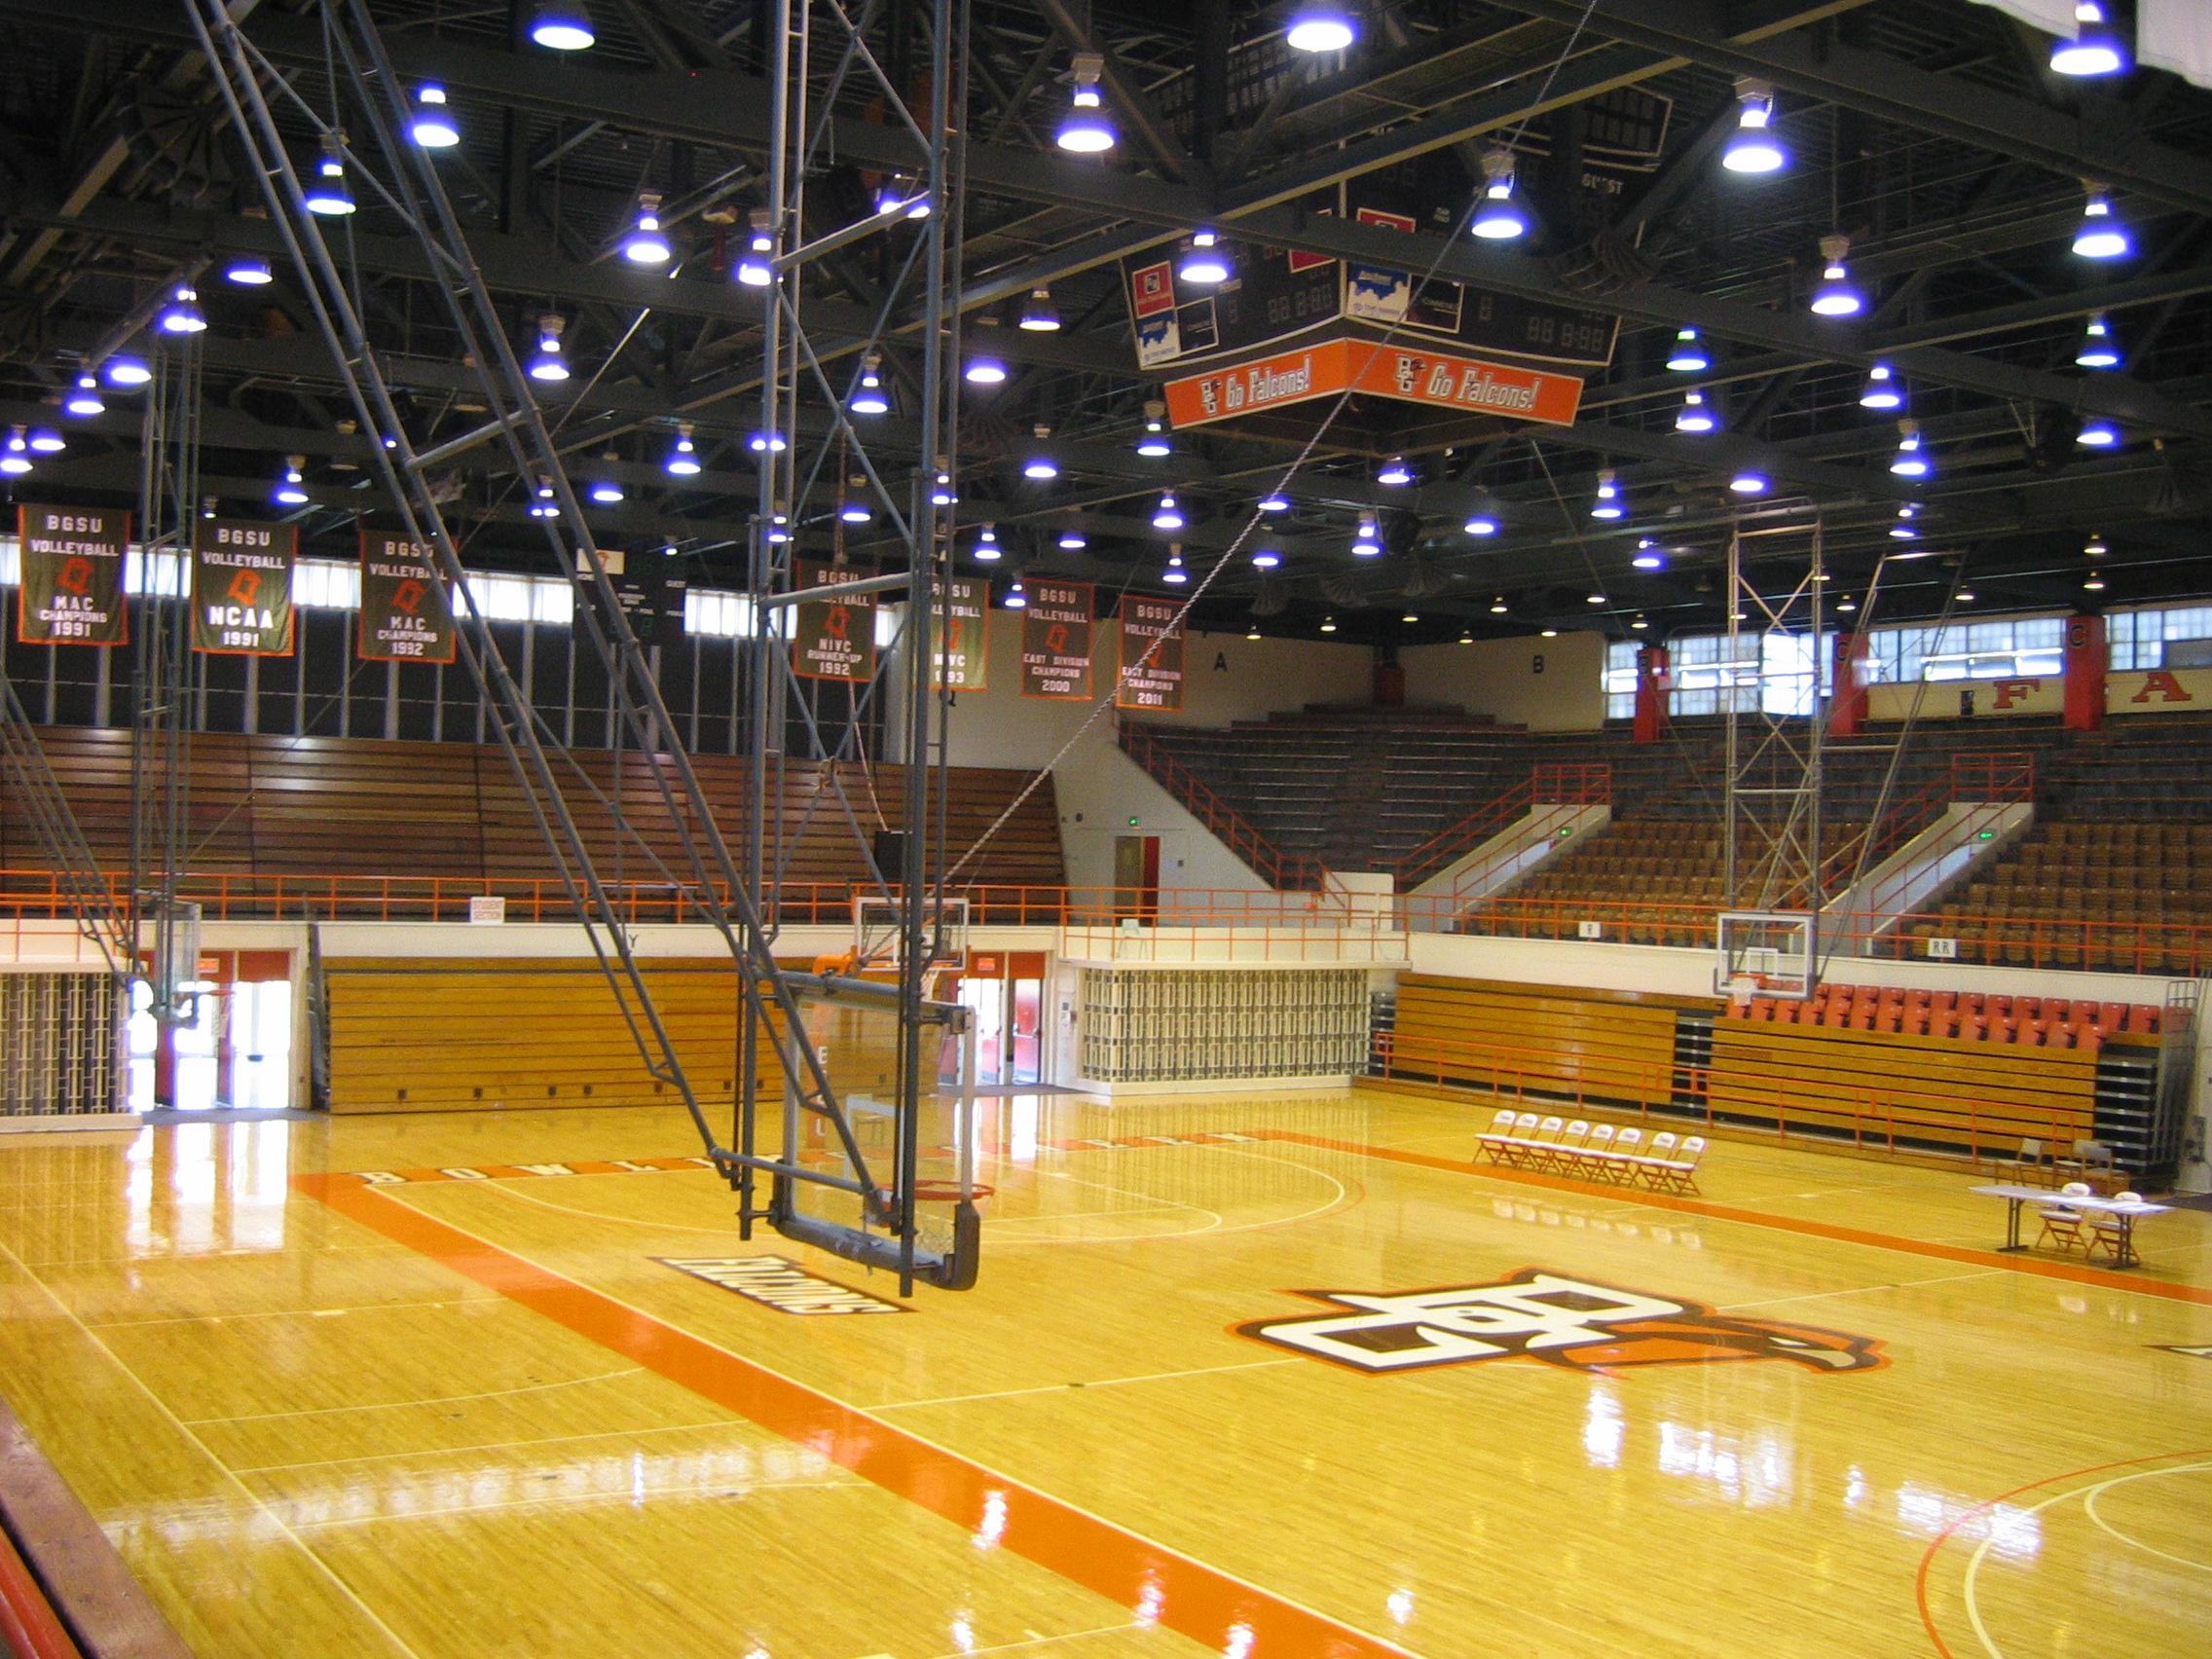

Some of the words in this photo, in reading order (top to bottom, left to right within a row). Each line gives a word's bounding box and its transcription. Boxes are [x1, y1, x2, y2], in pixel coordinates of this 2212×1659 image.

[1581, 173, 1624, 194] GUST
[1226, 374, 1244, 408] Go
[1247, 355, 1310, 404] Falcons!
[1427, 362, 1454, 398] Go
[1456, 367, 1541, 410] Falcons!
[46, 514, 102, 533] BGSU
[218, 528, 271, 546] BGSU
[31, 539, 120, 557] VOLLEYBALL
[385, 541, 434, 558] BGSU
[202, 551, 286, 570] VOLLEYBALL
[369, 563, 448, 580] VOLLEYBAL
[818, 570, 859, 584] BGSU
[55, 595, 94, 610] MAC
[1040, 588, 1076, 604] BGSU
[39, 609, 108, 623] CHAMPIONS
[208, 606, 274, 629] NCAA
[932, 604, 981, 617] LLYBALL
[1028, 608, 1088, 623] VOLLEYBALL
[1137, 605, 1172, 620] BGSU
[55, 622, 92, 637] 1991
[390, 616, 425, 631] MAC
[223, 631, 260, 647] 1991
[377, 629, 438, 643] CHAMPIONS
[2070, 624, 2086, 647] C
[391, 642, 424, 656] 1992
[819, 639, 852, 652] NIVC
[1836, 641, 1849, 662] C
[807, 649, 863, 663] RUNNER-UP
[935, 653, 966, 667] NVC
[1024, 653, 1047, 664] EAST
[1053, 656, 1090, 667] DIVISION
[1213, 652, 1228, 672] A
[820, 662, 851, 676] 1992
[1532, 654, 1544, 674] B
[935, 670, 965, 683] 193
[1032, 667, 1081, 679] CHAMPIONS
[1122, 666, 1143, 678] EAST
[1042, 680, 1071, 692] 2000
[1993, 679, 2041, 709] F
[2131, 671, 2192, 703] A
[1137, 692, 1163, 705] 2011
